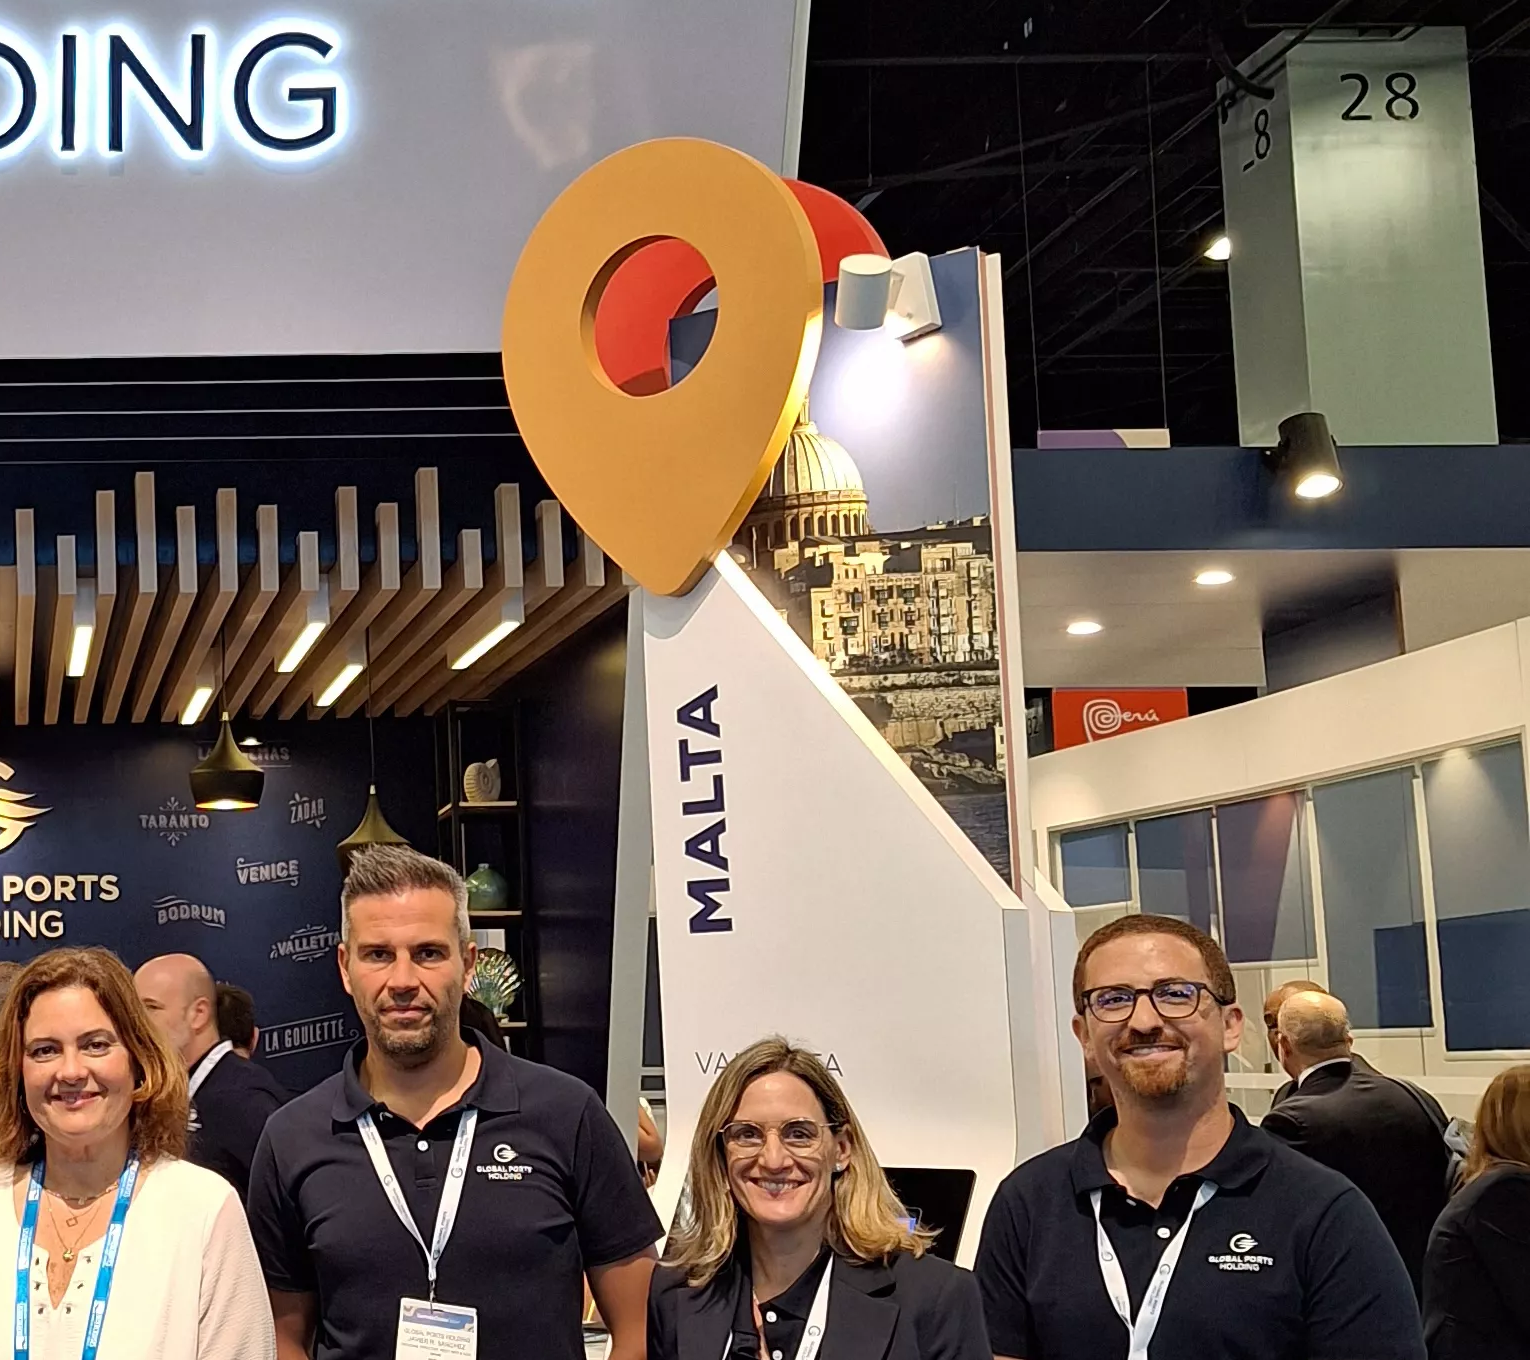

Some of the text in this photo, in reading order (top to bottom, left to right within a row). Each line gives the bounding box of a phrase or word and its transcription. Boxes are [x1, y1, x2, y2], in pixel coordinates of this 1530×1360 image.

[1339, 72, 1420, 121] 28
[139, 814, 210, 829] TARANTO
[290, 798, 324, 824] ZADAR
[677, 684, 734, 934] MALTA
[236, 859, 299, 885] VENICE
[2, 874, 120, 902] PORTS
[157, 904, 226, 925] BODRUM
[277, 931, 340, 956] VALLETTA
[265, 1019, 344, 1052] LA GOULETTE
[476, 1165, 507, 1173] GLOBAL
[1208, 1255, 1274, 1265] GLOBAL PORTS
[1219, 1263, 1260, 1271] HOLDING
